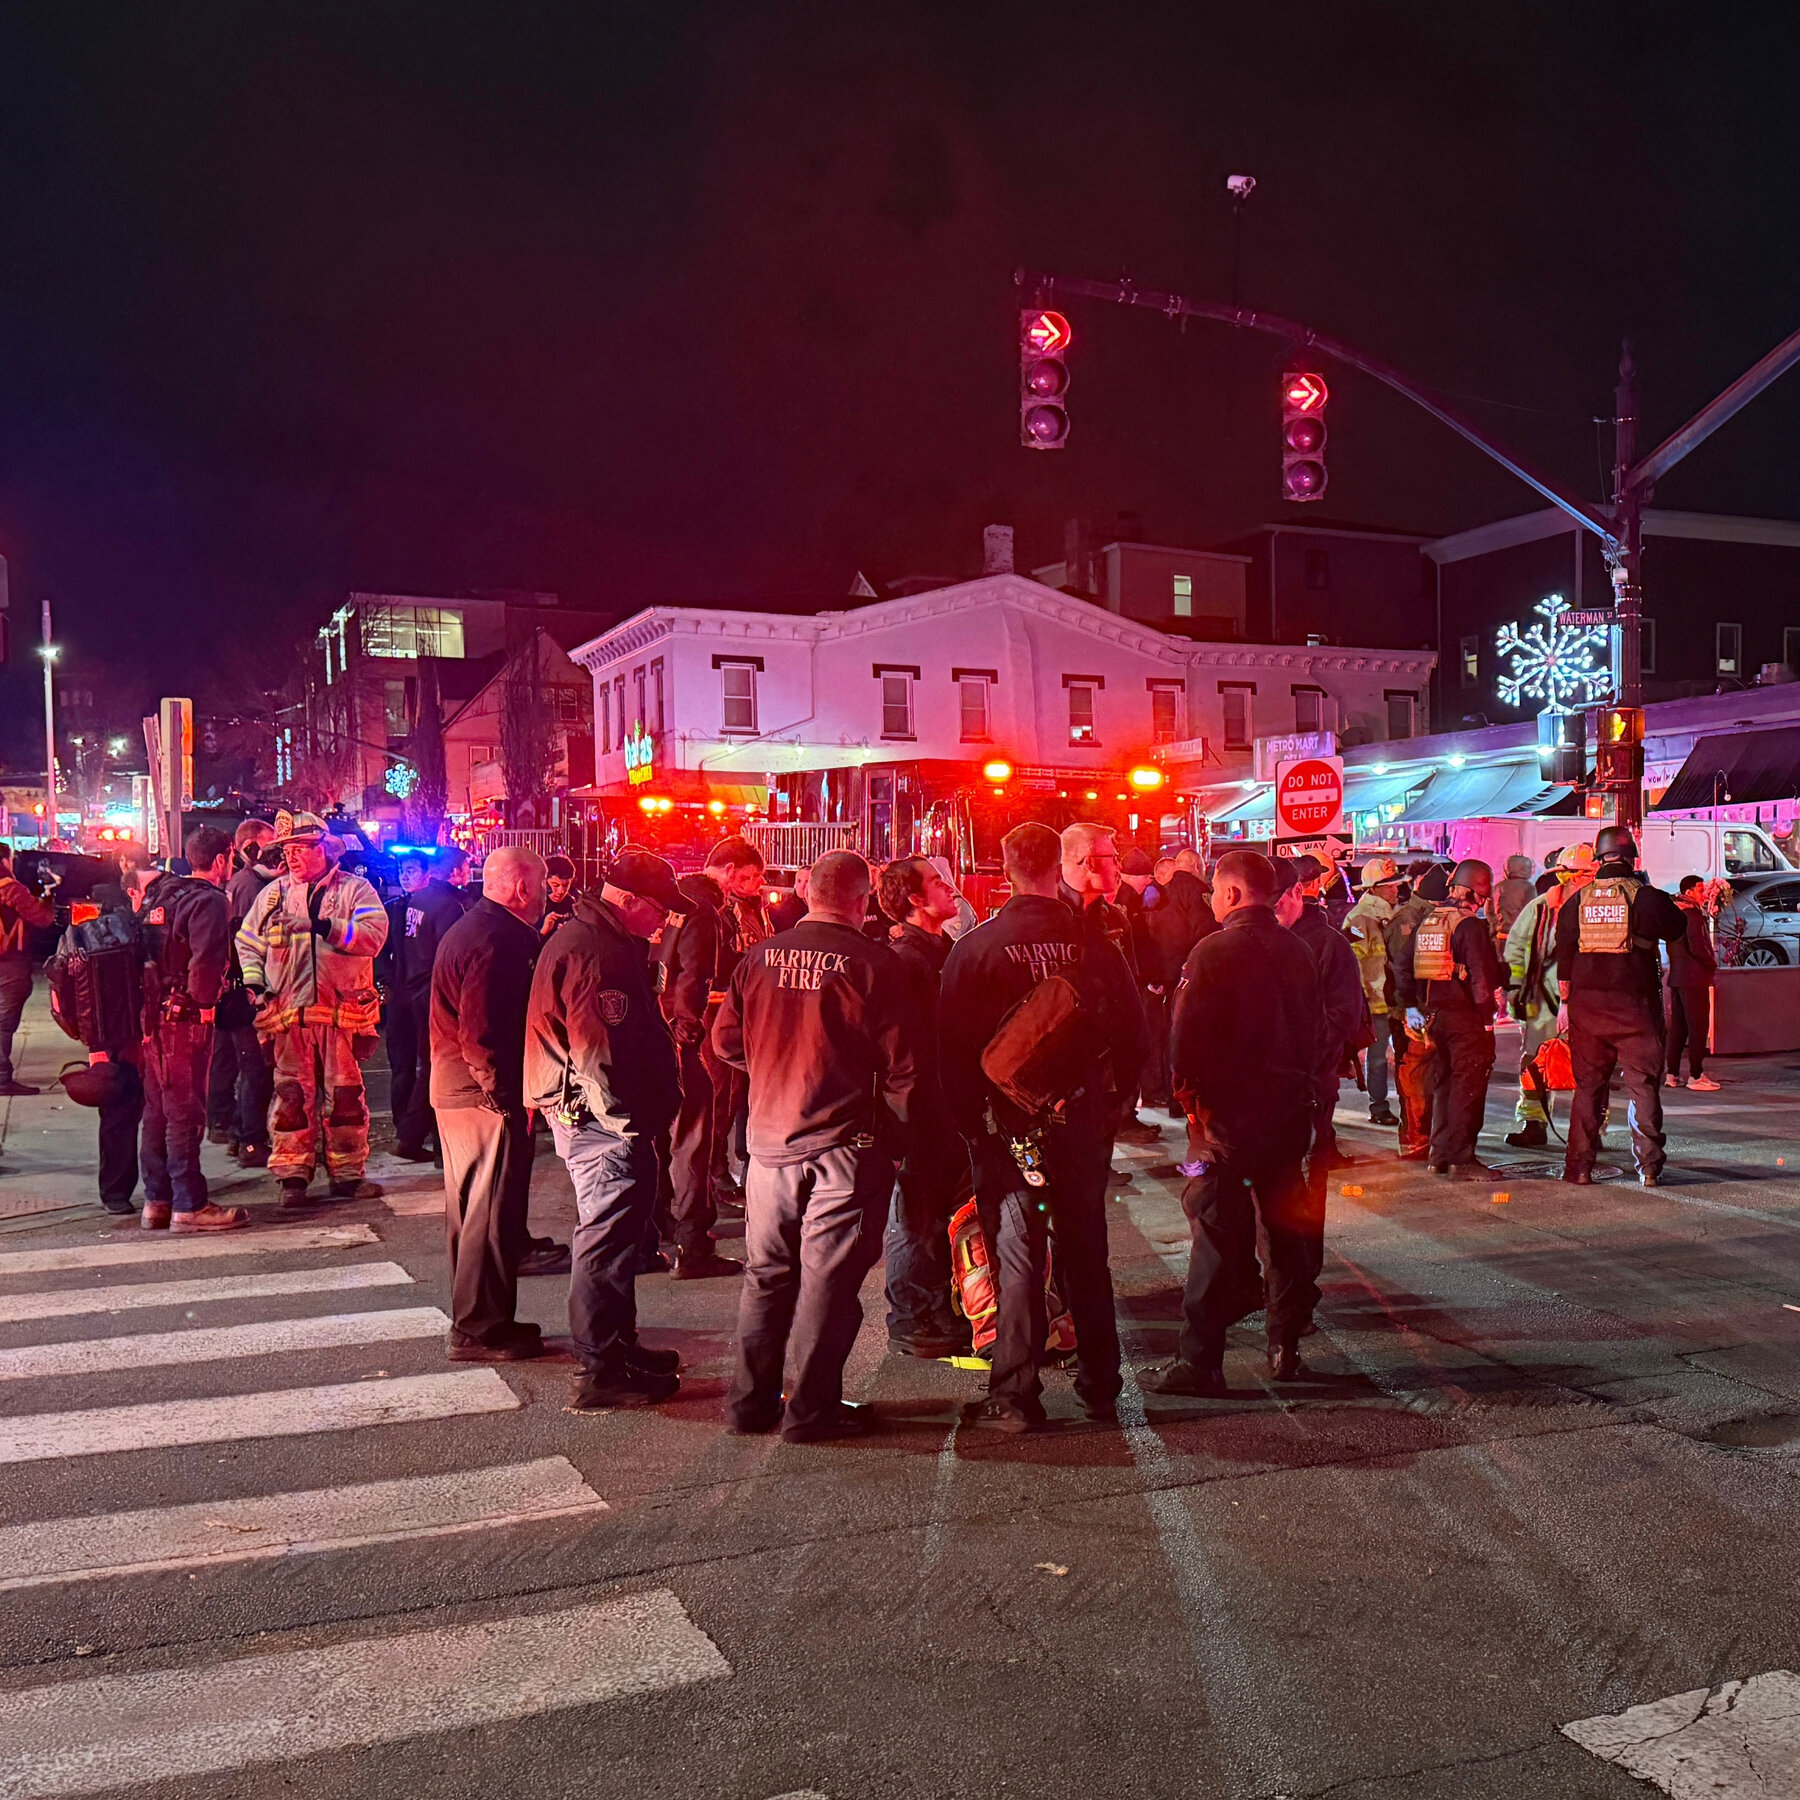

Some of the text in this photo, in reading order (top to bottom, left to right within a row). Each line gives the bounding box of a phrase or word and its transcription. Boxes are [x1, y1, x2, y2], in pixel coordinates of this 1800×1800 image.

[1559, 611, 1605, 625] WATERMAN
[1295, 736, 1320, 750] MART
[1288, 773, 1333, 788] DO NOT
[1292, 806, 1328, 820] ENTER
[1304, 842, 1326, 851] WAY
[1585, 905, 1626, 918] RESCUE
[764, 948, 850, 974] WARWICK
[777, 967, 823, 991] FIRE
